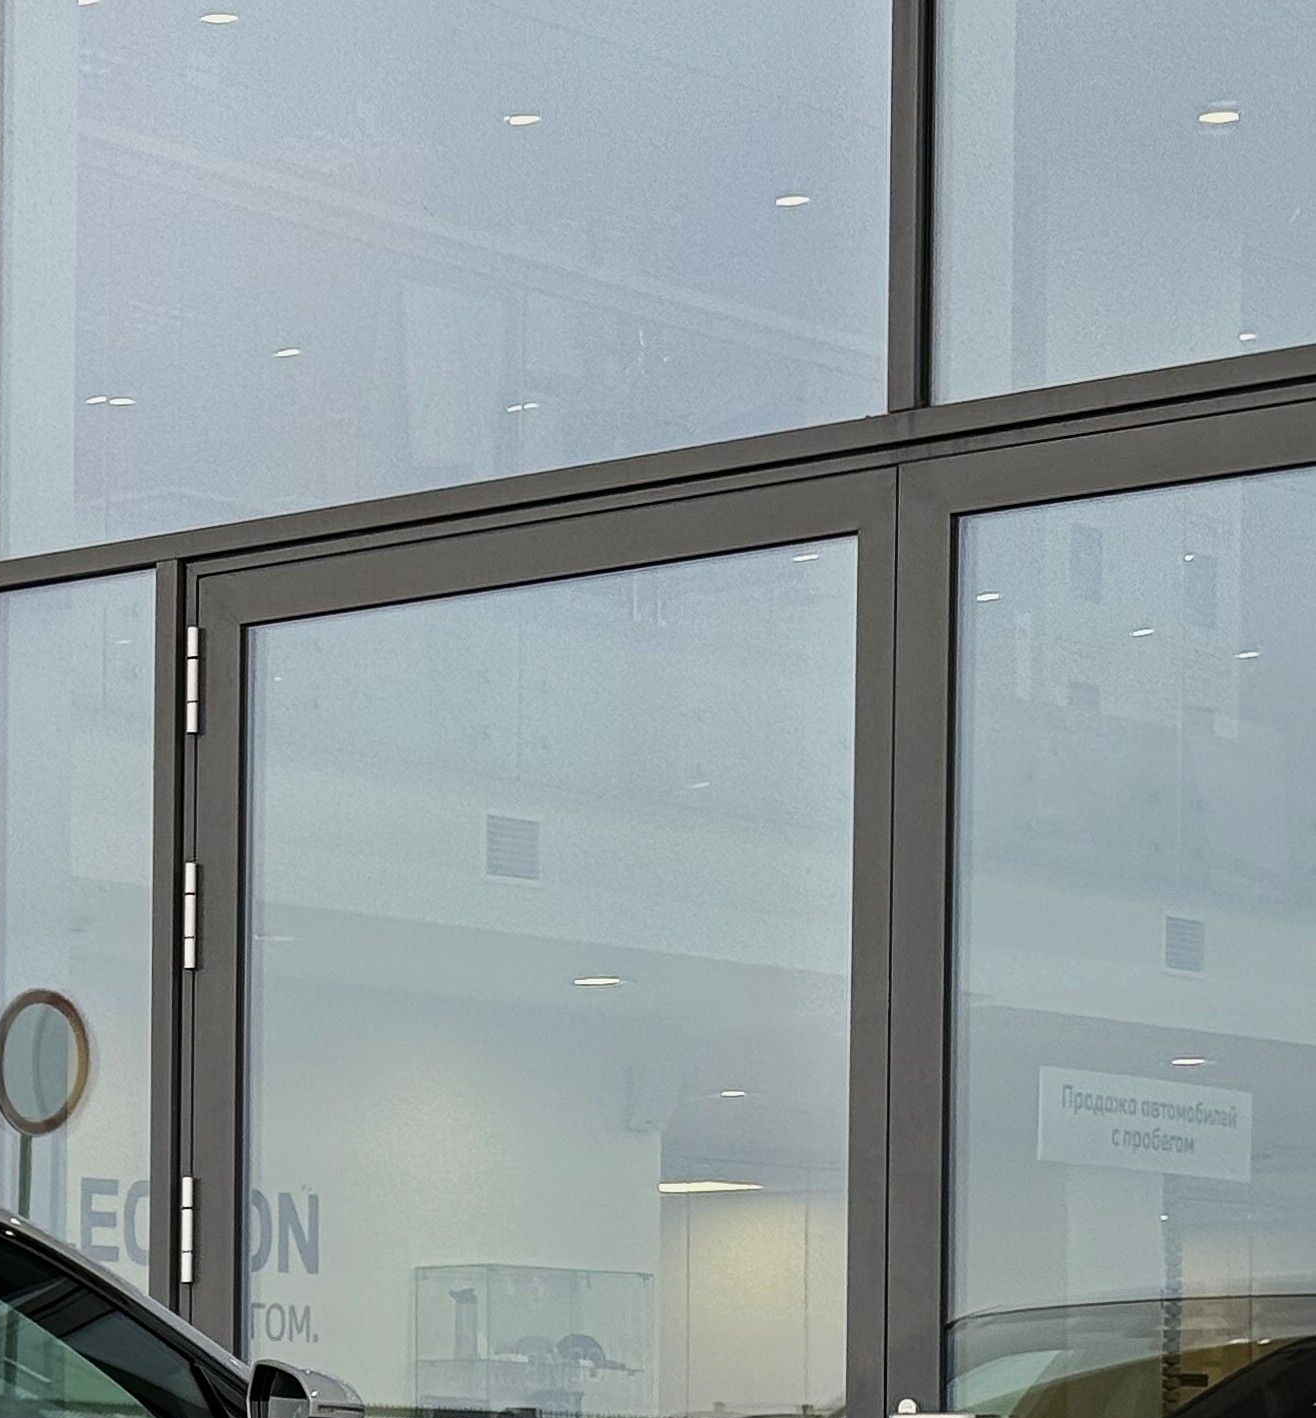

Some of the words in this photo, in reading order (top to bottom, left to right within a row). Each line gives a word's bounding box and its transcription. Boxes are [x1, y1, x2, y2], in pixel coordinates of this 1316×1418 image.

[1061, 1084, 1137, 1117] Продажа
[1140, 1099, 1238, 1128] автомобилей
[1122, 1126, 1195, 1155] пробегом
